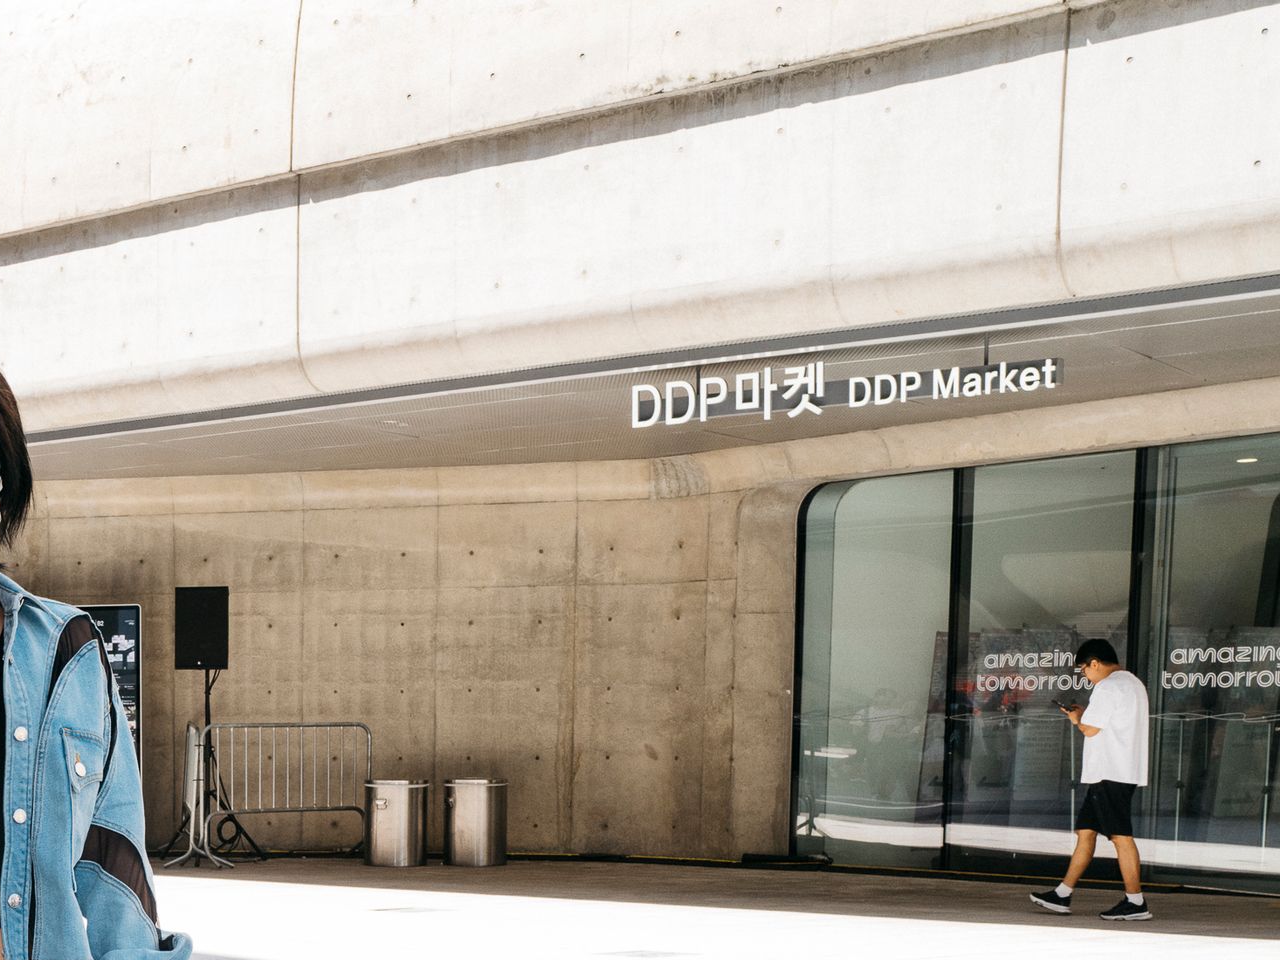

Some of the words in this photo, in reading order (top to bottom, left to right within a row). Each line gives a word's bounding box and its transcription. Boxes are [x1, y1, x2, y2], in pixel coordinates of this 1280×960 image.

[631, 361, 825, 428] DDP마켓
[849, 371, 922, 408] DDP
[932, 358, 1057, 400] Market
[984, 649, 1081, 672] amazin
